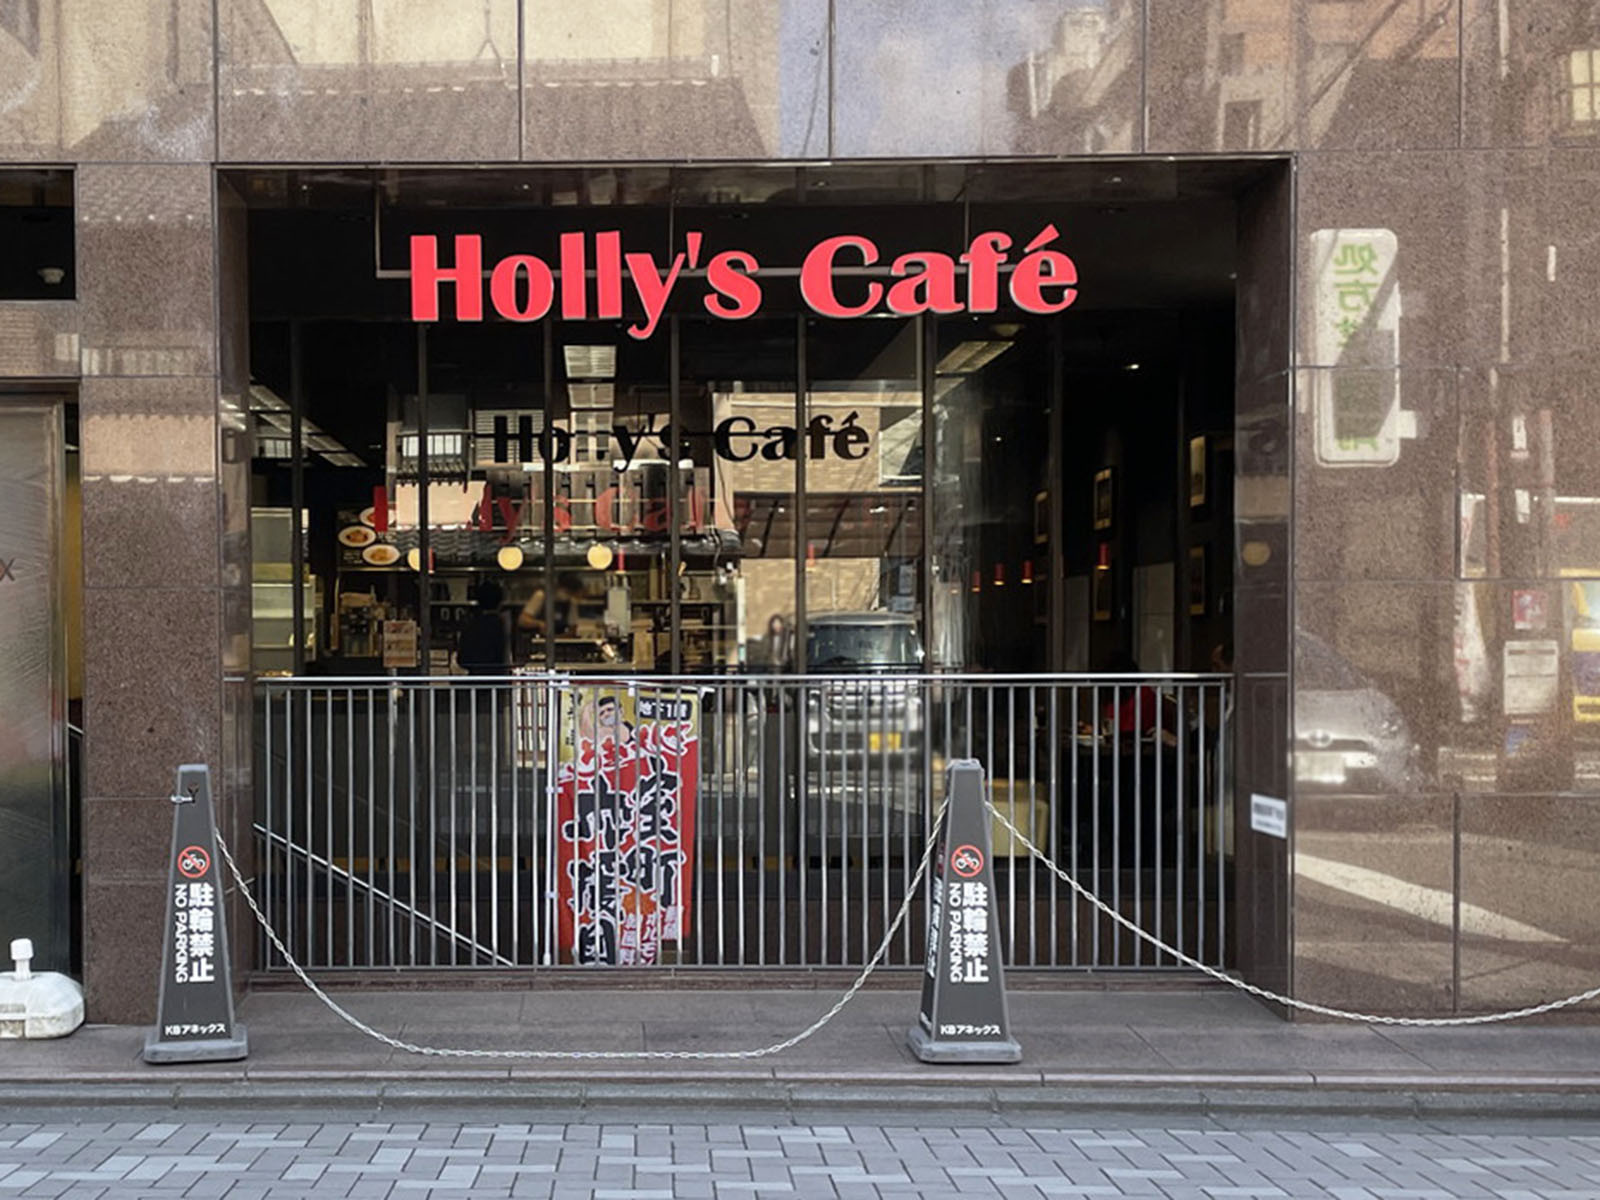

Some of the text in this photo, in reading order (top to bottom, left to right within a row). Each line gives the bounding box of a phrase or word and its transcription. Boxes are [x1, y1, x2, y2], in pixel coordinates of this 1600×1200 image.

[409, 224, 1078, 341] Holly's Café
[715, 411, 870, 461] Café
[175, 884, 188, 983] NO PARKING
[189, 882, 214, 983] 駐輪禁止
[949, 883, 963, 982] NO PARKING
[963, 882, 989, 983] 駐輪禁止
